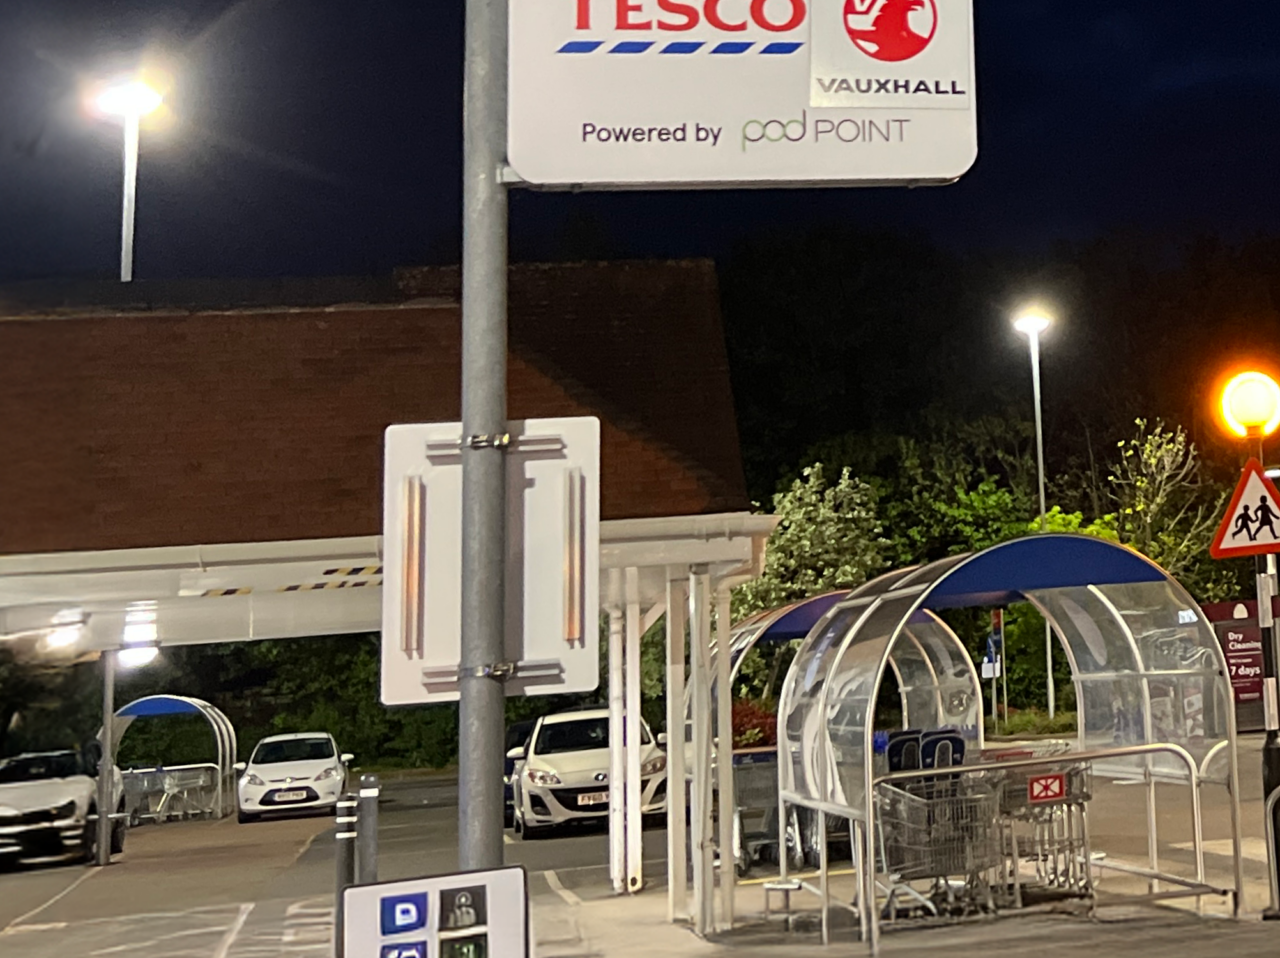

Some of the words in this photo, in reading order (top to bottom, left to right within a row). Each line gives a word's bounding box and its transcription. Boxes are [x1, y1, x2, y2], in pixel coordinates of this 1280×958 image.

[816, 78, 967, 96] VAUXHALL
[582, 122, 687, 143] Powered
[696, 122, 723, 146] by
[741, 108, 807, 152] pod
[815, 118, 912, 143] POINT
[1228, 632, 1244, 643] Dry
[1238, 664, 1261, 676] days
